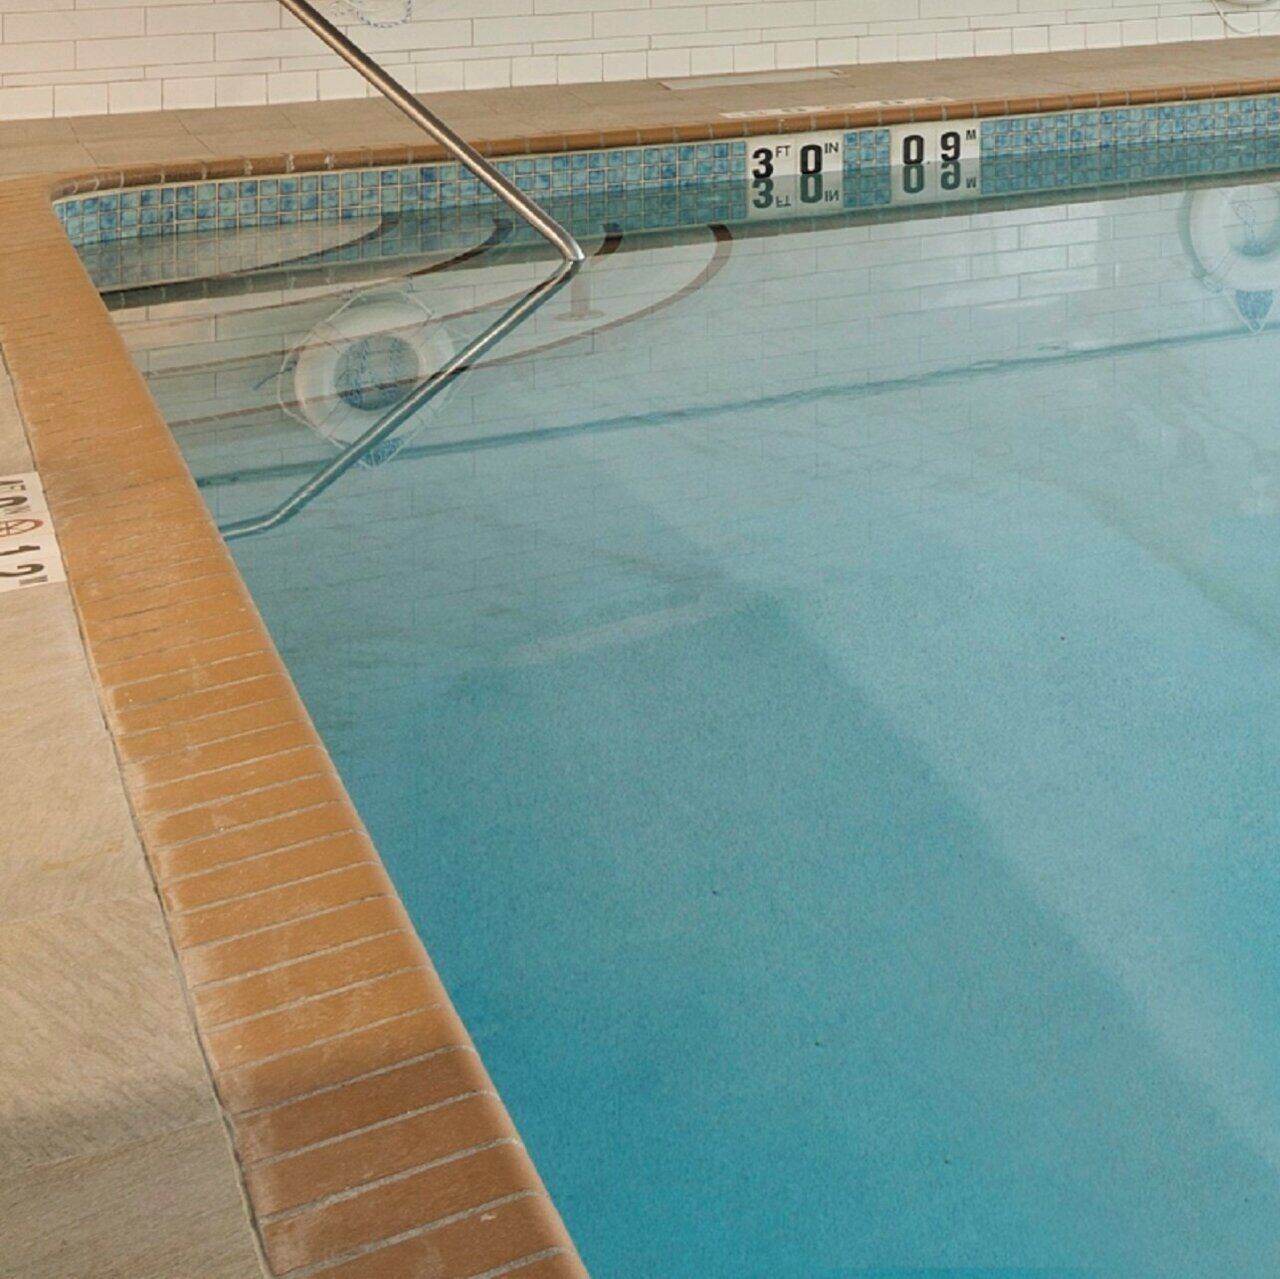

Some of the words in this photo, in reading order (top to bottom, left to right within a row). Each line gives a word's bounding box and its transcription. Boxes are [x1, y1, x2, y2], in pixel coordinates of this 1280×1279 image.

[966, 129, 976, 140] M
[752, 148, 773, 179] 3
[776, 144, 791, 157] FT
[800, 144, 822, 175] 0
[824, 141, 839, 154] IN
